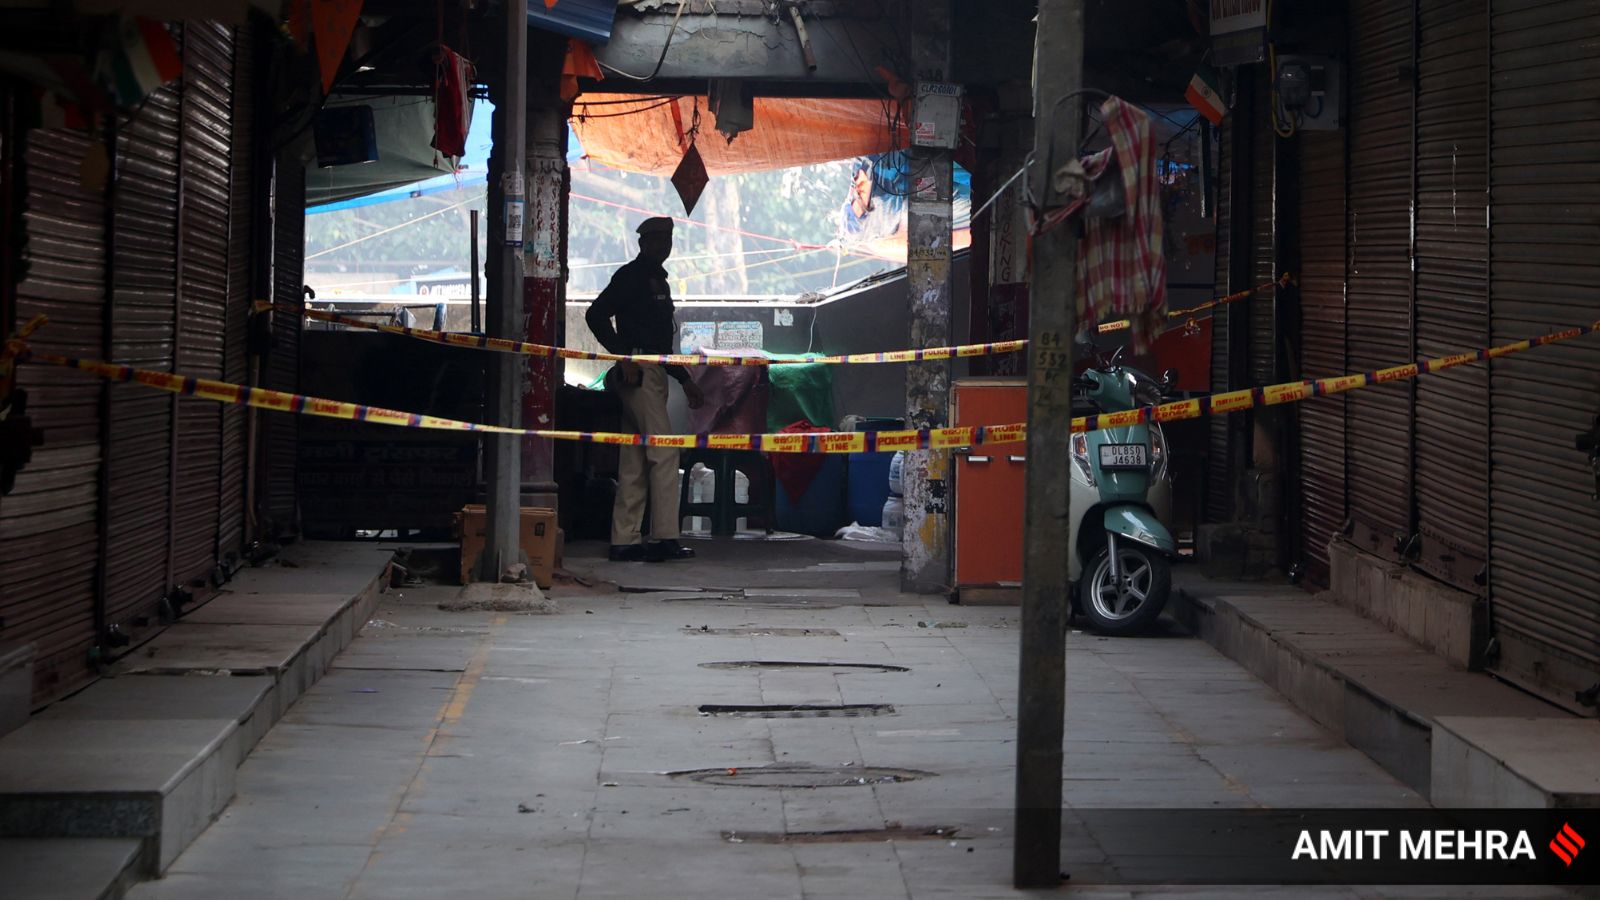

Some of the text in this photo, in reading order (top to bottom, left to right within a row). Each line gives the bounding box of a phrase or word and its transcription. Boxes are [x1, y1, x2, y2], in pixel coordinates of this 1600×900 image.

[649, 437, 685, 446] CROSS
[878, 435, 919, 446] POLICE
[993, 433, 1017, 442] LINE
[825, 443, 849, 451] LINE
